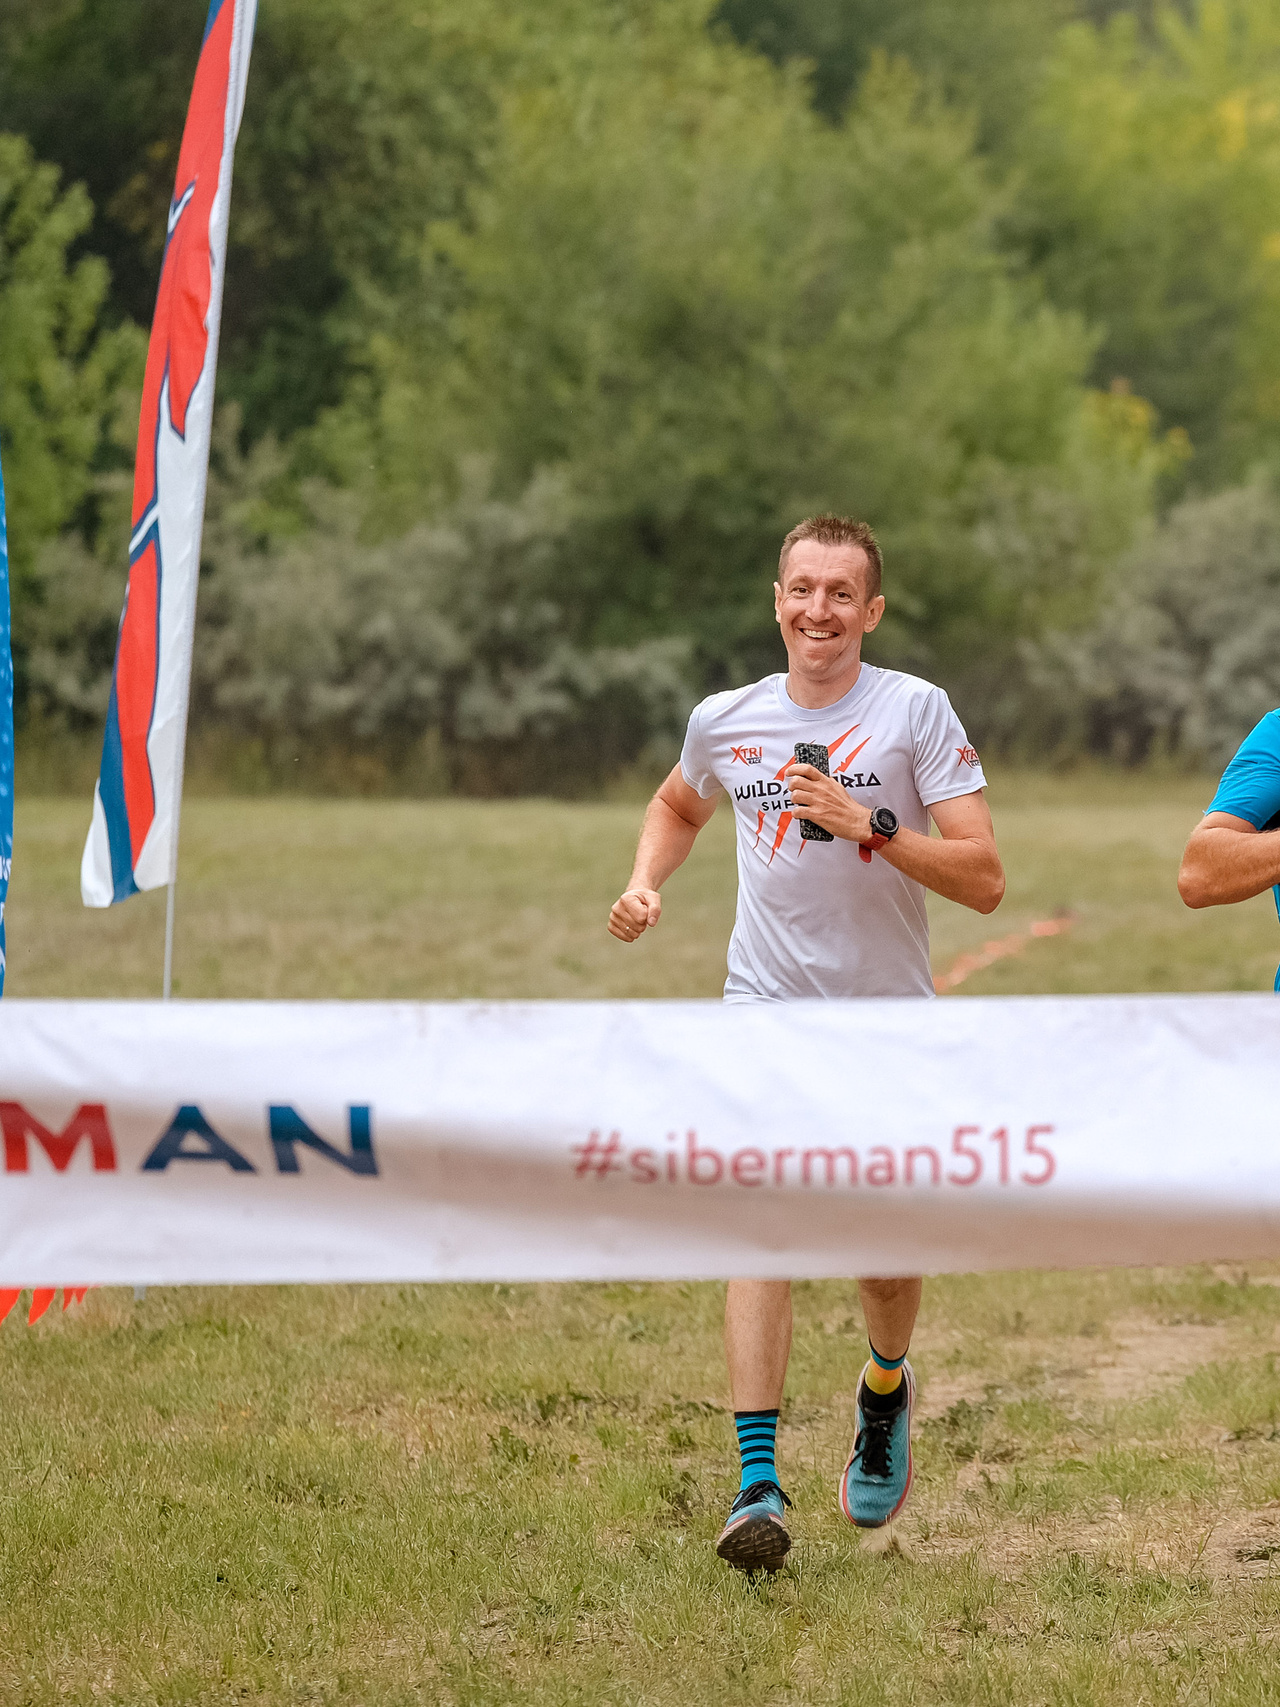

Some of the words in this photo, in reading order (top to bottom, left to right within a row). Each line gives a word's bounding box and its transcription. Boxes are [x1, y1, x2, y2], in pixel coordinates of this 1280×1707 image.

[730, 745, 763, 766] XTRI
[955, 745, 980, 769] XTR
[0, 1102, 378, 1175] MAN
[570, 1123, 1057, 1188] #siberman515
